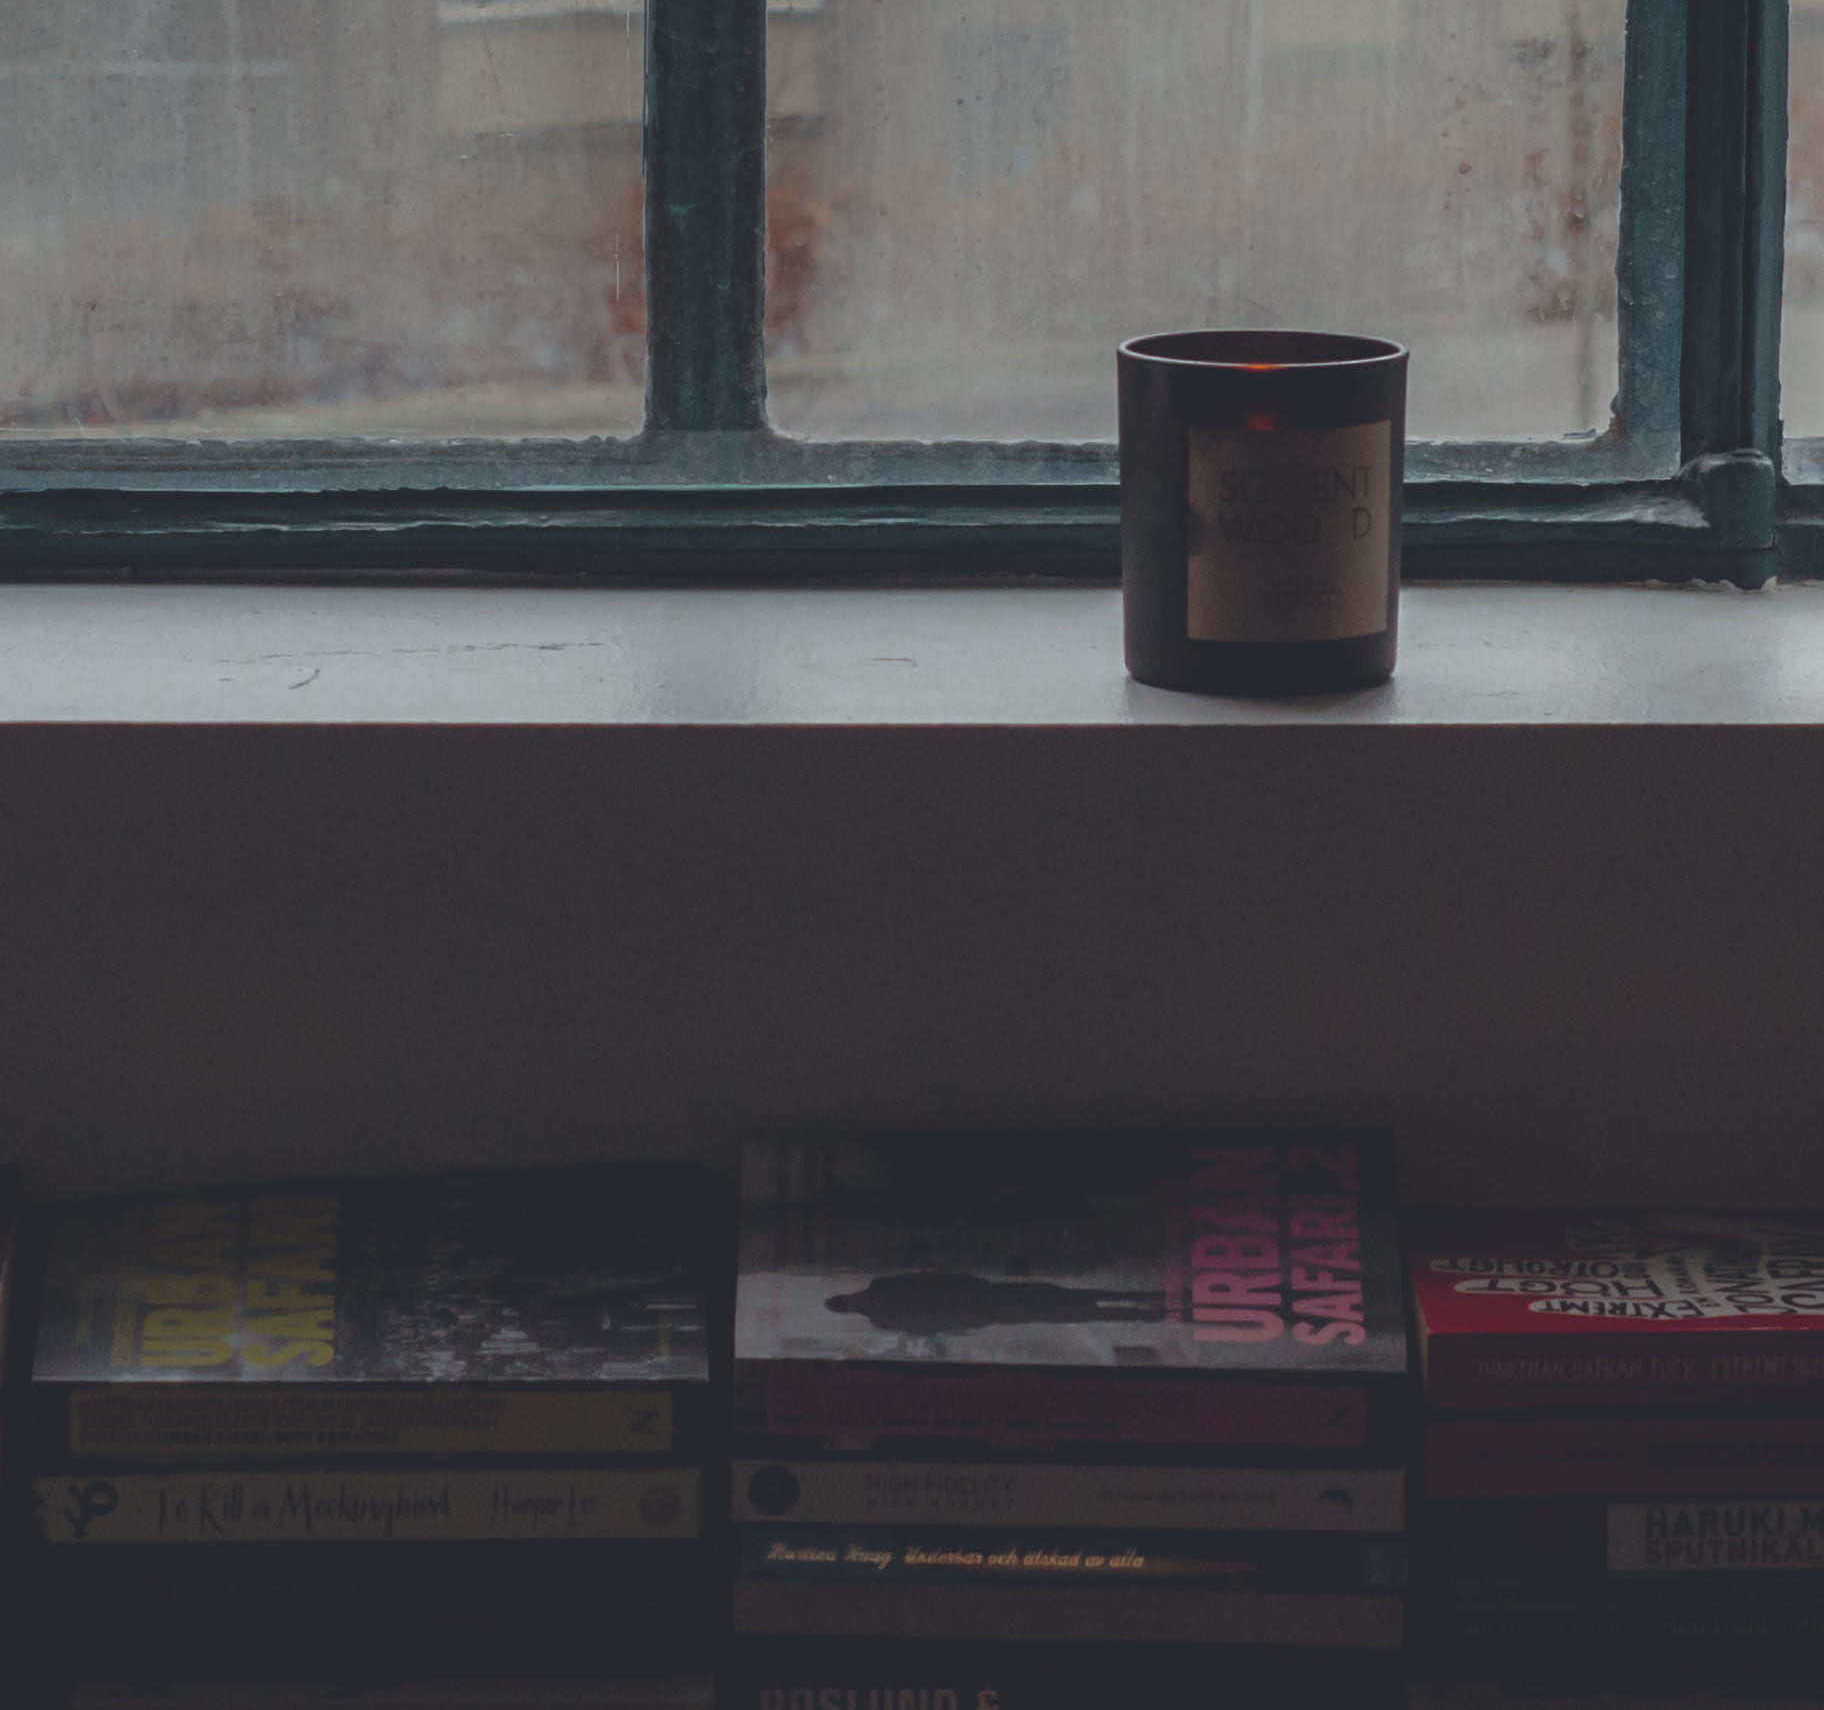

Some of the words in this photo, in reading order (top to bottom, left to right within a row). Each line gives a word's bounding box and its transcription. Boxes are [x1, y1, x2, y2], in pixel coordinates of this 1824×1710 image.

[1191, 1146, 1285, 1343] URBAN
[141, 1202, 238, 1367] URBAN
[238, 1198, 339, 1367] SAFARI
[1540, 1299, 1704, 1318] EXTREMT
[1473, 1359, 1567, 1382] JONATHAN
[1573, 1359, 1642, 1380] SAFRAN
[1652, 1358, 1694, 1379] FOER
[1711, 1358, 1789, 1380] EXTREMT
[198, 1484, 244, 1535] Kill
[1645, 1505, 1786, 1538] HARUKI
[987, 1545, 1019, 1566] och
[1109, 1546, 1145, 1569] alla
